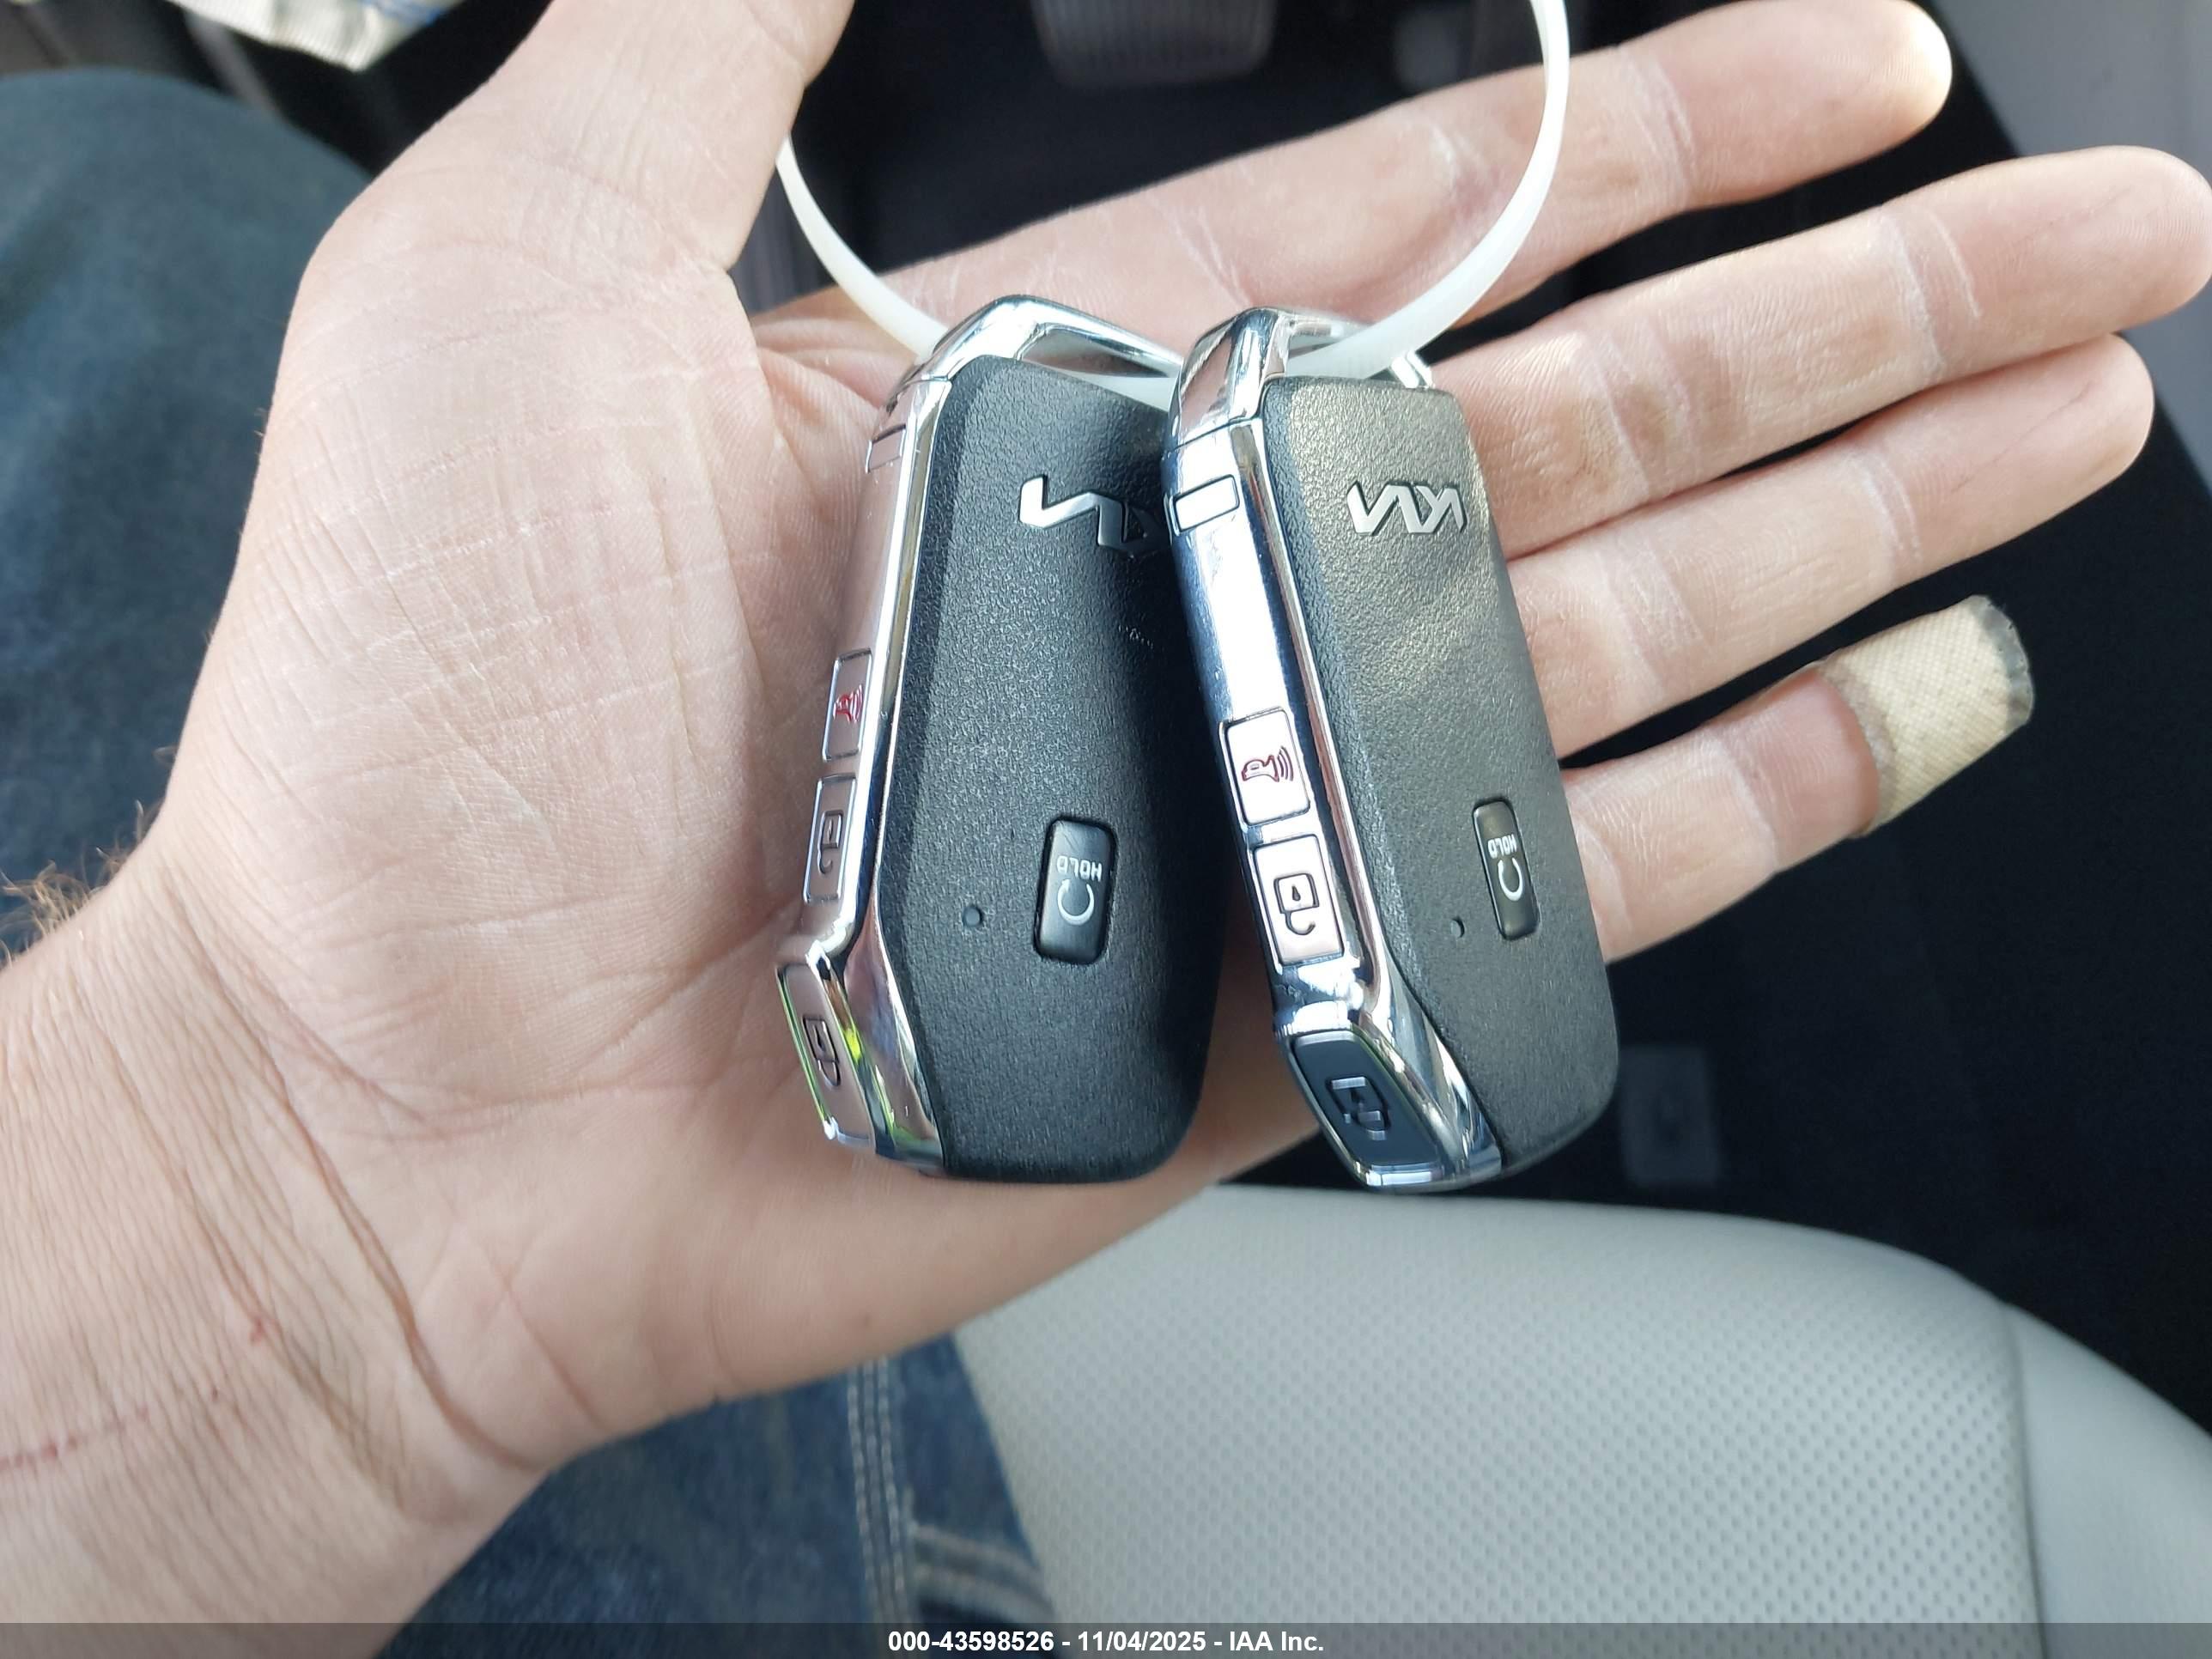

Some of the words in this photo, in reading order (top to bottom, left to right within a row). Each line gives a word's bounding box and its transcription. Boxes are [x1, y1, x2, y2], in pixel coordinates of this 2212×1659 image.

[1346, 482, 1467, 534] KIA
[1487, 834, 1517, 859] HOLD
[1057, 856, 1102, 882] HOLD
